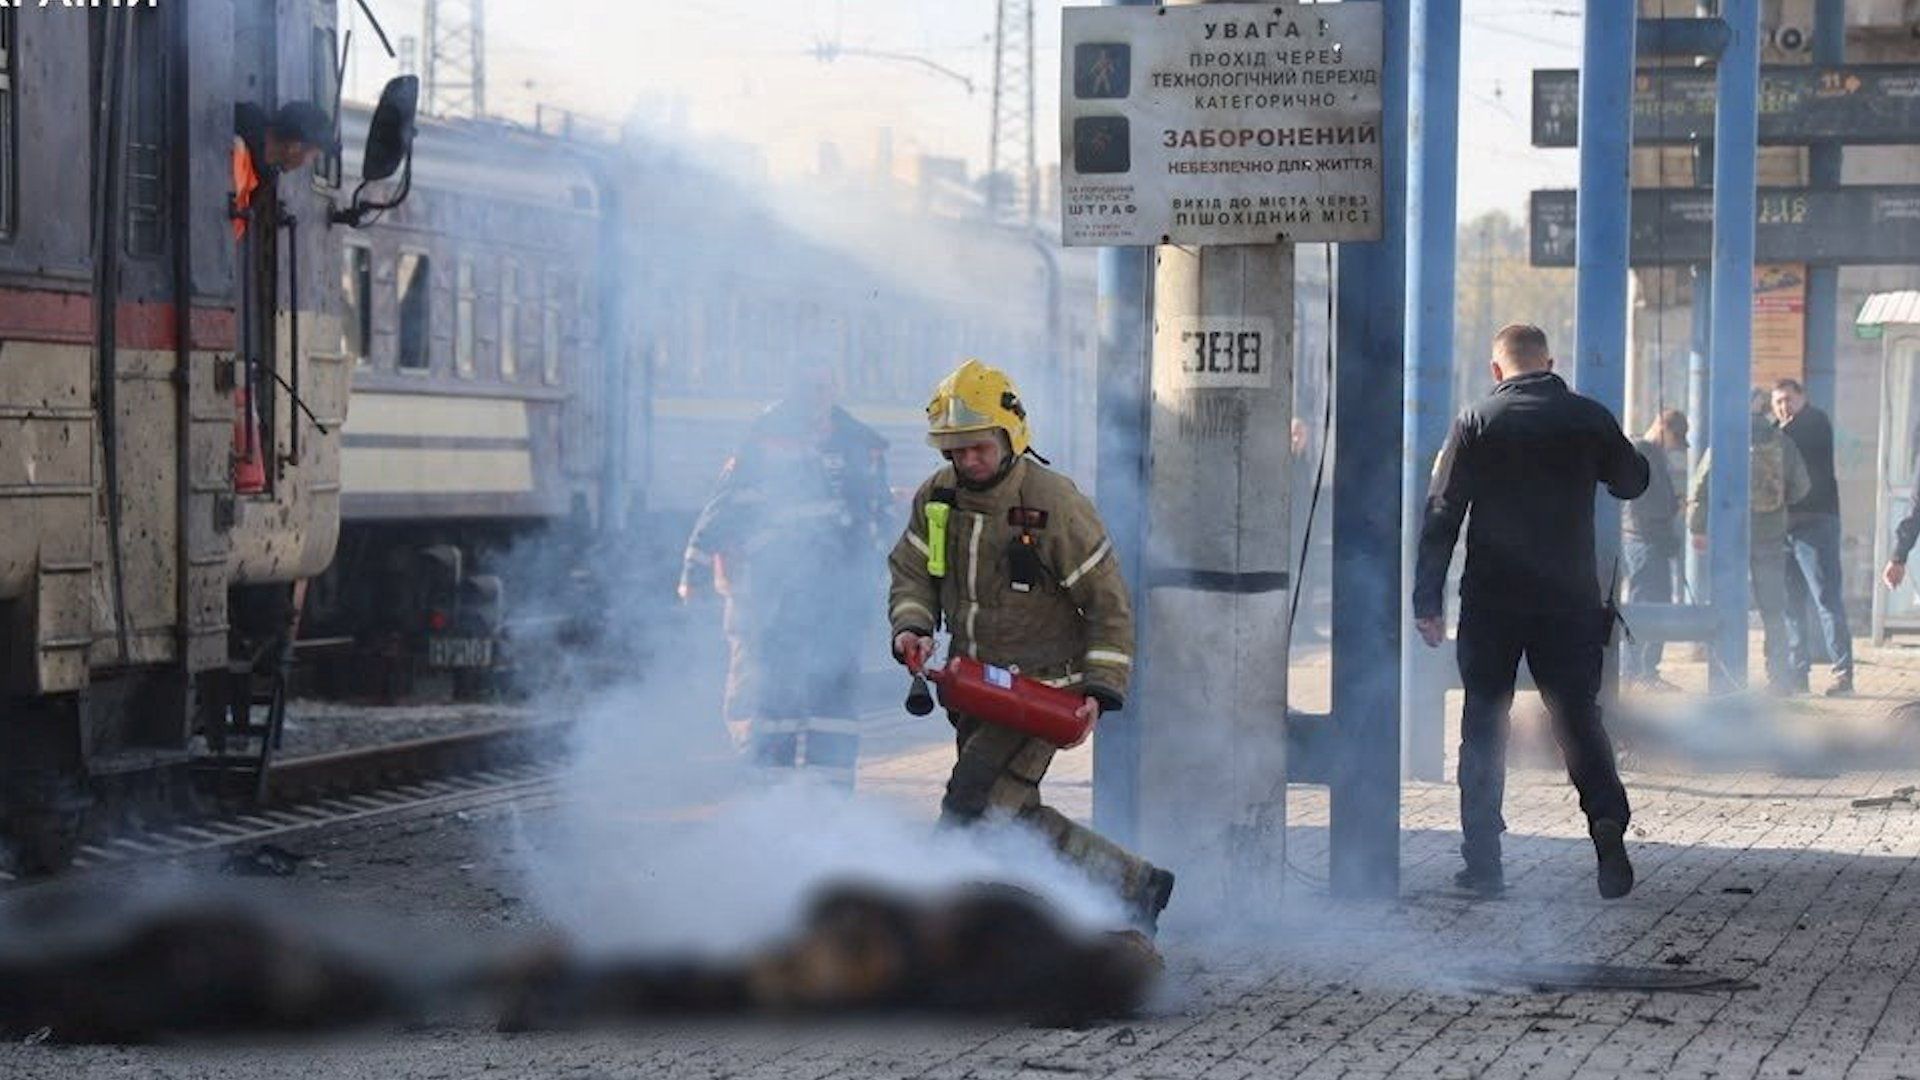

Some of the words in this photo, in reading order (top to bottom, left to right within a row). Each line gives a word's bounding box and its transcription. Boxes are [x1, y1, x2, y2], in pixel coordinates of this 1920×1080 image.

[1204, 22, 1300, 40] УВАГА
[1189, 52, 1266, 67] ПРОХІД
[1277, 49, 1343, 65] ЧЕРЕЗ
[1152, 69, 1298, 88] ТЕХНОЛОГІЧНИЙ
[1302, 69, 1377, 85] ПЕРЕХІД
[1194, 93, 1336, 109] КАТЕГОРИЧНО
[1162, 122, 1377, 148] ЗАБОРОНЕНИЙ
[1168, 159, 1274, 174] НЕБЕЗПЕЧНО
[1276, 159, 1312, 174] ДЛЯ
[1314, 157, 1373, 171] ЖИТТЯ
[1068, 204, 1137, 215] ШТРАФ
[1172, 197, 1222, 209] ВИХІД
[1229, 198, 1251, 209] ДО
[1259, 197, 1309, 208] МІСТА
[1316, 195, 1368, 208] ЧЕРЕЗ
[1176, 208, 1311, 226] ПІШОХІДНИЙ
[1322, 209, 1372, 223] МІСТ
[1181, 331, 1260, 374] 388
